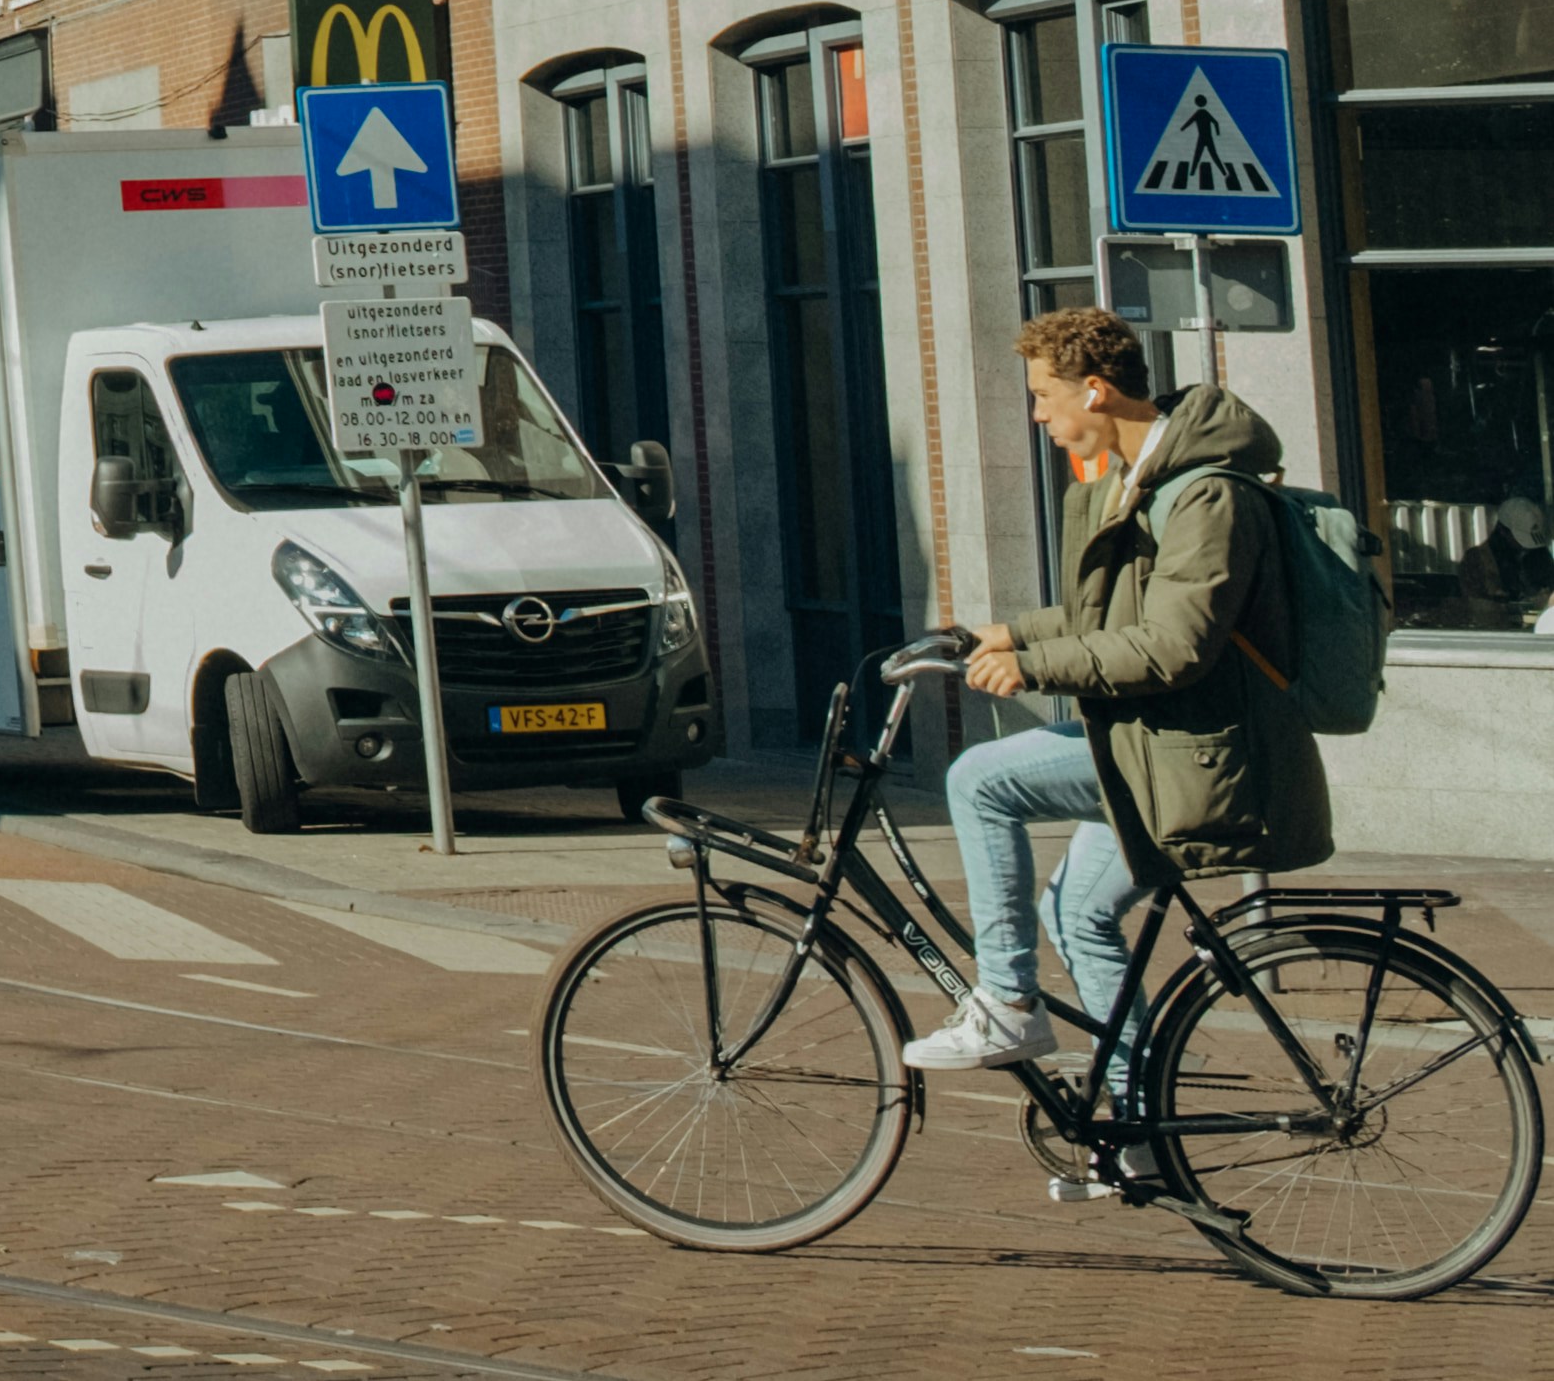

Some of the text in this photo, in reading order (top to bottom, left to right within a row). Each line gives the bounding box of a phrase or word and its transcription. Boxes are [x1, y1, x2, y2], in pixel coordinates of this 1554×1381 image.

[140, 187, 207, 203] CWS
[327, 237, 454, 259] Uitgezonderd
[329, 263, 456, 281] (snor)fietsers
[347, 301, 444, 322] uitgezonderd
[347, 324, 446, 340] (snor)fietsers
[336, 346, 454, 368] en uitgezonderd
[333, 367, 465, 388] laad en losverkeer
[420, 394, 436, 406] za
[441, 410, 450, 424] h
[455, 412, 471, 424] en
[509, 707, 597, 729] VFS-42-F
